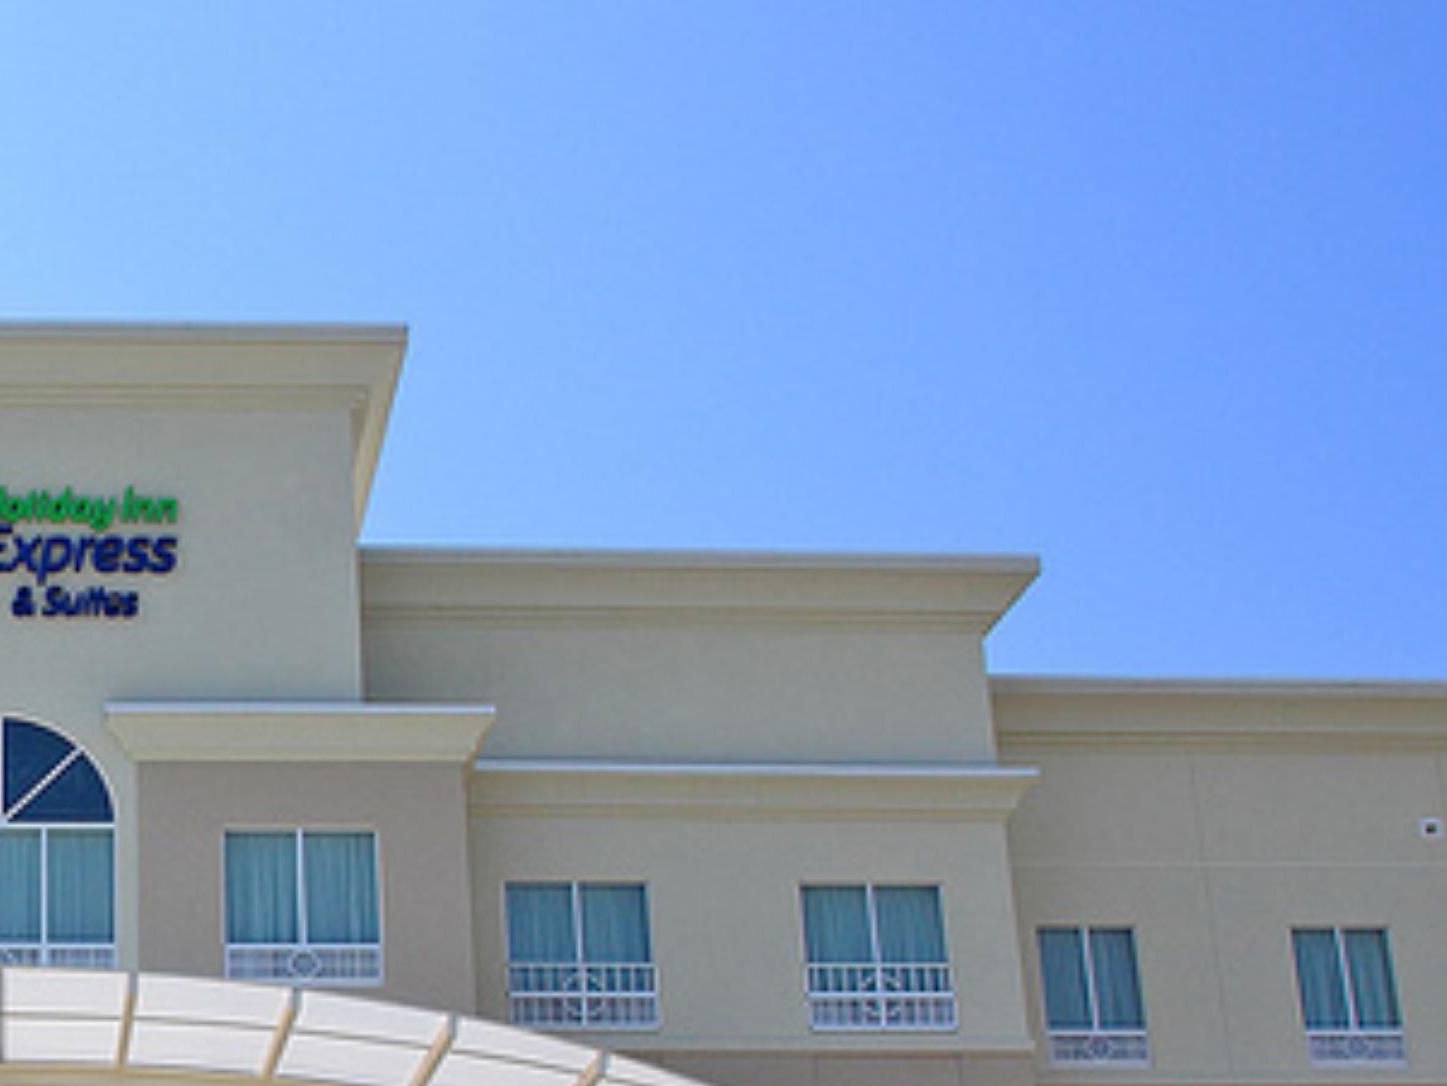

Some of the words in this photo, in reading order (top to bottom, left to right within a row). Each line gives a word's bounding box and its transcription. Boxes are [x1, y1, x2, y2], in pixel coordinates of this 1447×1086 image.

[120, 486, 178, 523] Inn
[11, 587, 36, 616] &
[42, 586, 138, 616] Suites
